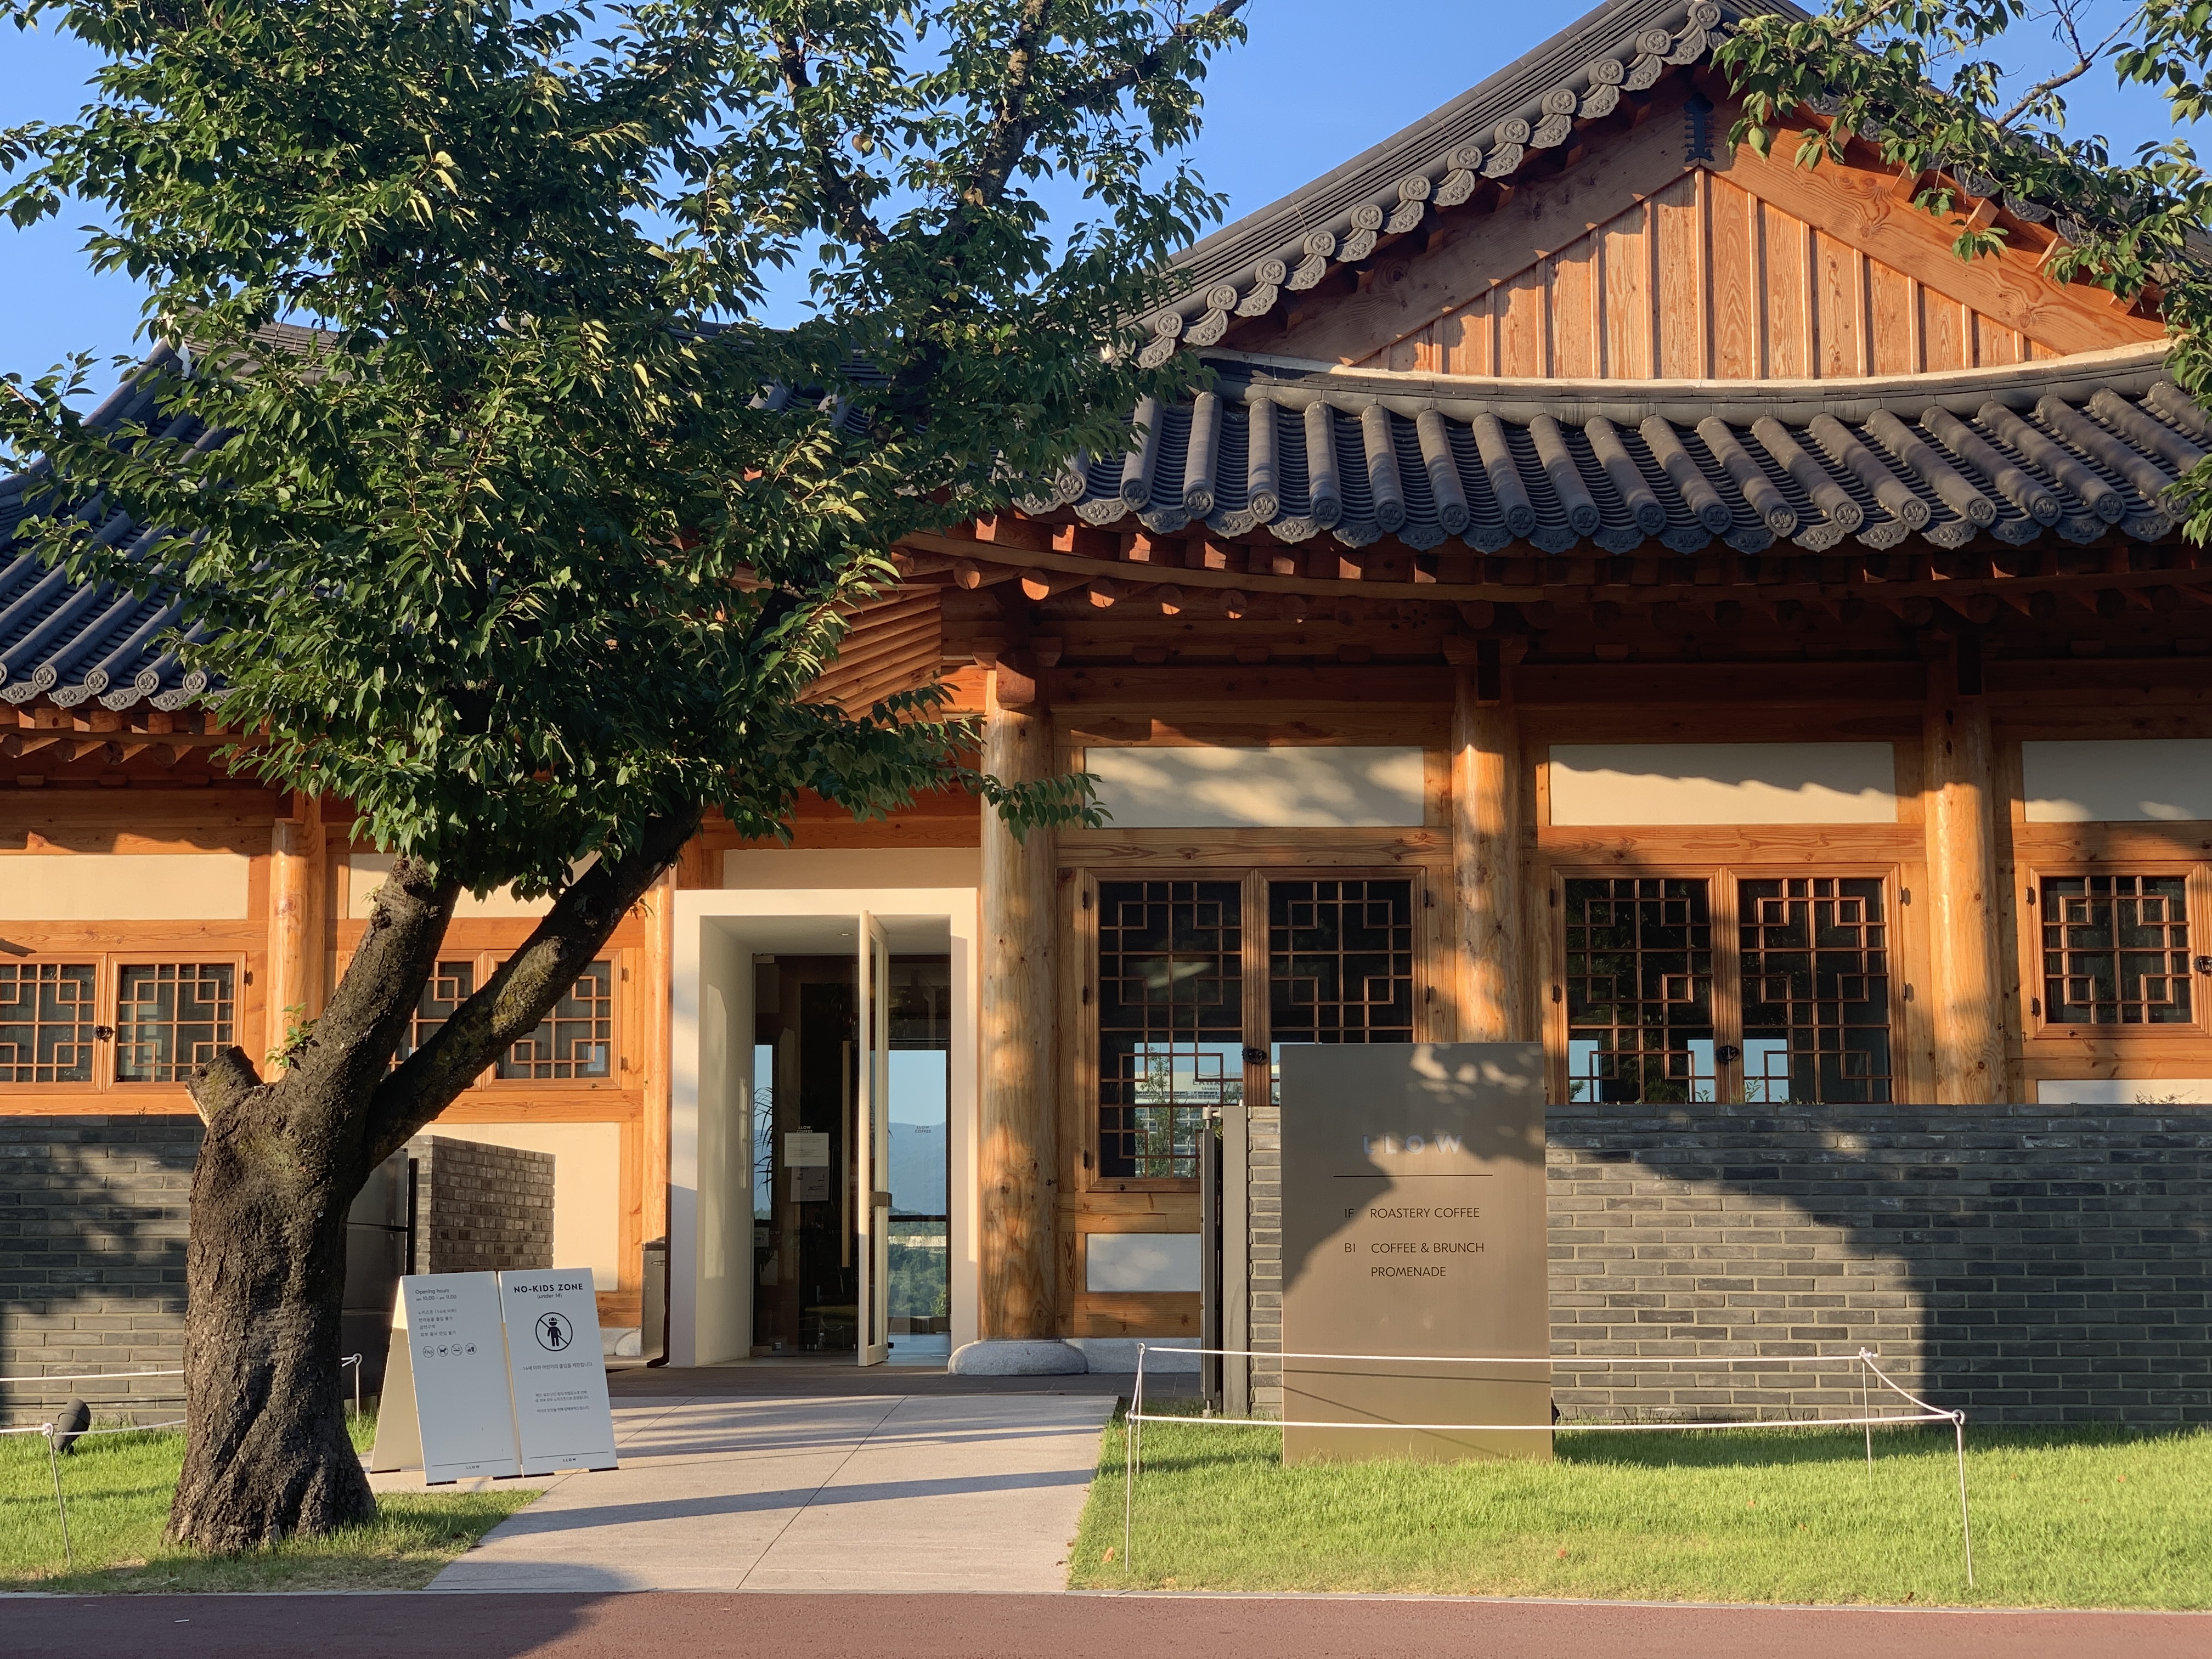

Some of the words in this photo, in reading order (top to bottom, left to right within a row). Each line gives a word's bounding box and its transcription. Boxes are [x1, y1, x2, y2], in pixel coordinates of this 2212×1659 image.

[1362, 1133, 1463, 1154] LLOW
[1344, 1208, 1355, 1218] 1F
[1370, 1208, 1430, 1218] ROASTERY
[1434, 1207, 1480, 1218] COFFEE
[1371, 1243, 1417, 1253] COFFEE
[1420, 1243, 1430, 1253] &
[1434, 1242, 1484, 1252] BRUNCH
[1371, 1267, 1446, 1277] PROMENADE
[514, 1284, 554, 1293] NO-KIDS
